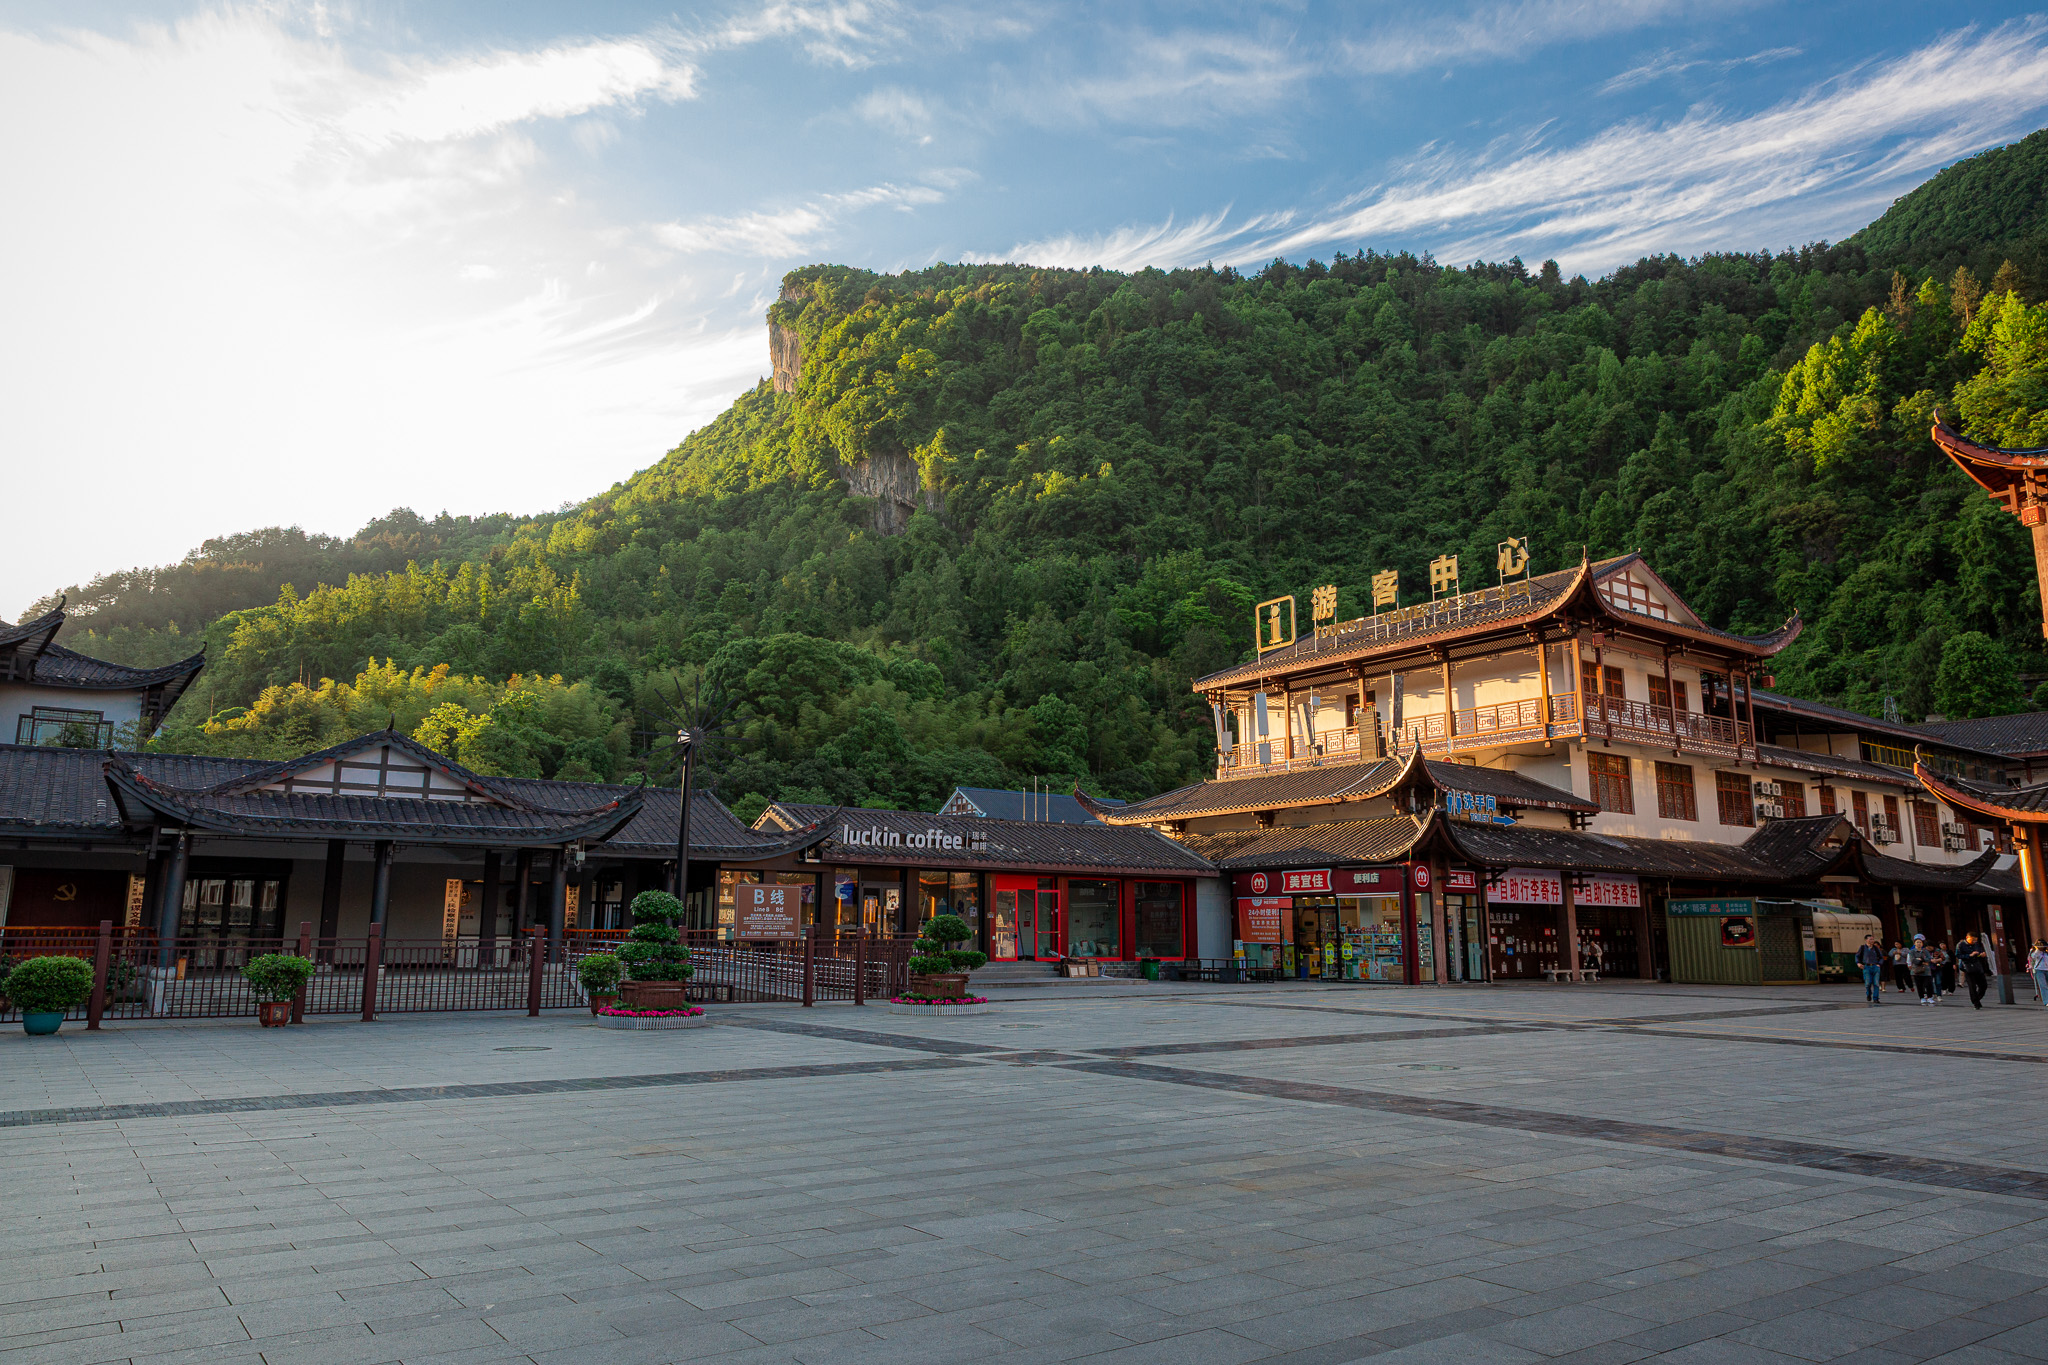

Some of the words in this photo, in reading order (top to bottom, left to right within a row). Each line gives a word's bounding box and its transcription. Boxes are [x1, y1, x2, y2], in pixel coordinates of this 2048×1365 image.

[1312, 537, 1529, 621] 游客中心
[1313, 620, 1364, 640] TOURIST
[1382, 604, 1430, 625] CENTER
[1463, 791, 1496, 812] 洗手间
[1470, 813, 1490, 822] TOILET
[842, 824, 900, 847] luckin
[906, 828, 962, 850] coffee
[972, 831, 988, 841] 瑞幸
[972, 841, 987, 851] 咖啡
[1289, 873, 1324, 889] 美宜佳
[1353, 872, 1380, 884] 便利店
[754, 889, 765, 904] B
[771, 889, 785, 906] 线
[1500, 877, 1560, 902] 自助行李寄存
[1585, 881, 1638, 905] 自助行李寄存
